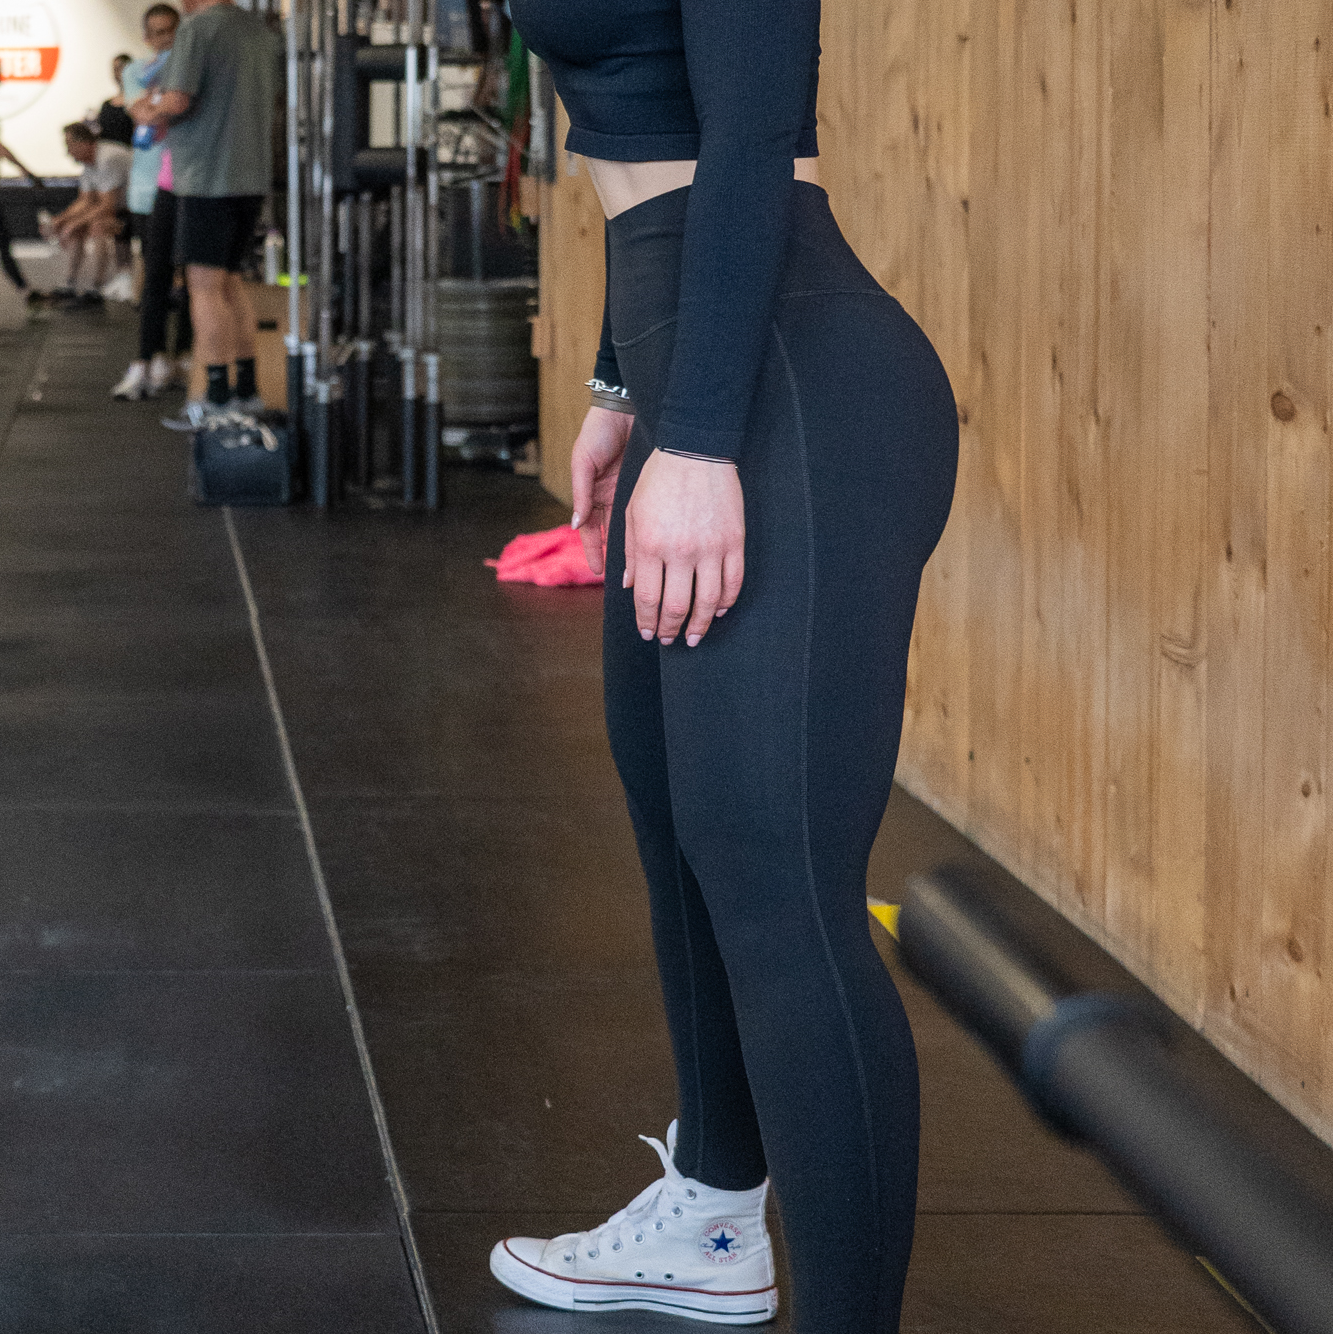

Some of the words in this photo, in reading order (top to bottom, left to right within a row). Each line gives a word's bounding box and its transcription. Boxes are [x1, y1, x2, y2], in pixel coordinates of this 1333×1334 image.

[704, 1222, 742, 1237] CONVERSE
[704, 1251, 716, 1262] ALL
[719, 1252, 738, 1263] STAR
